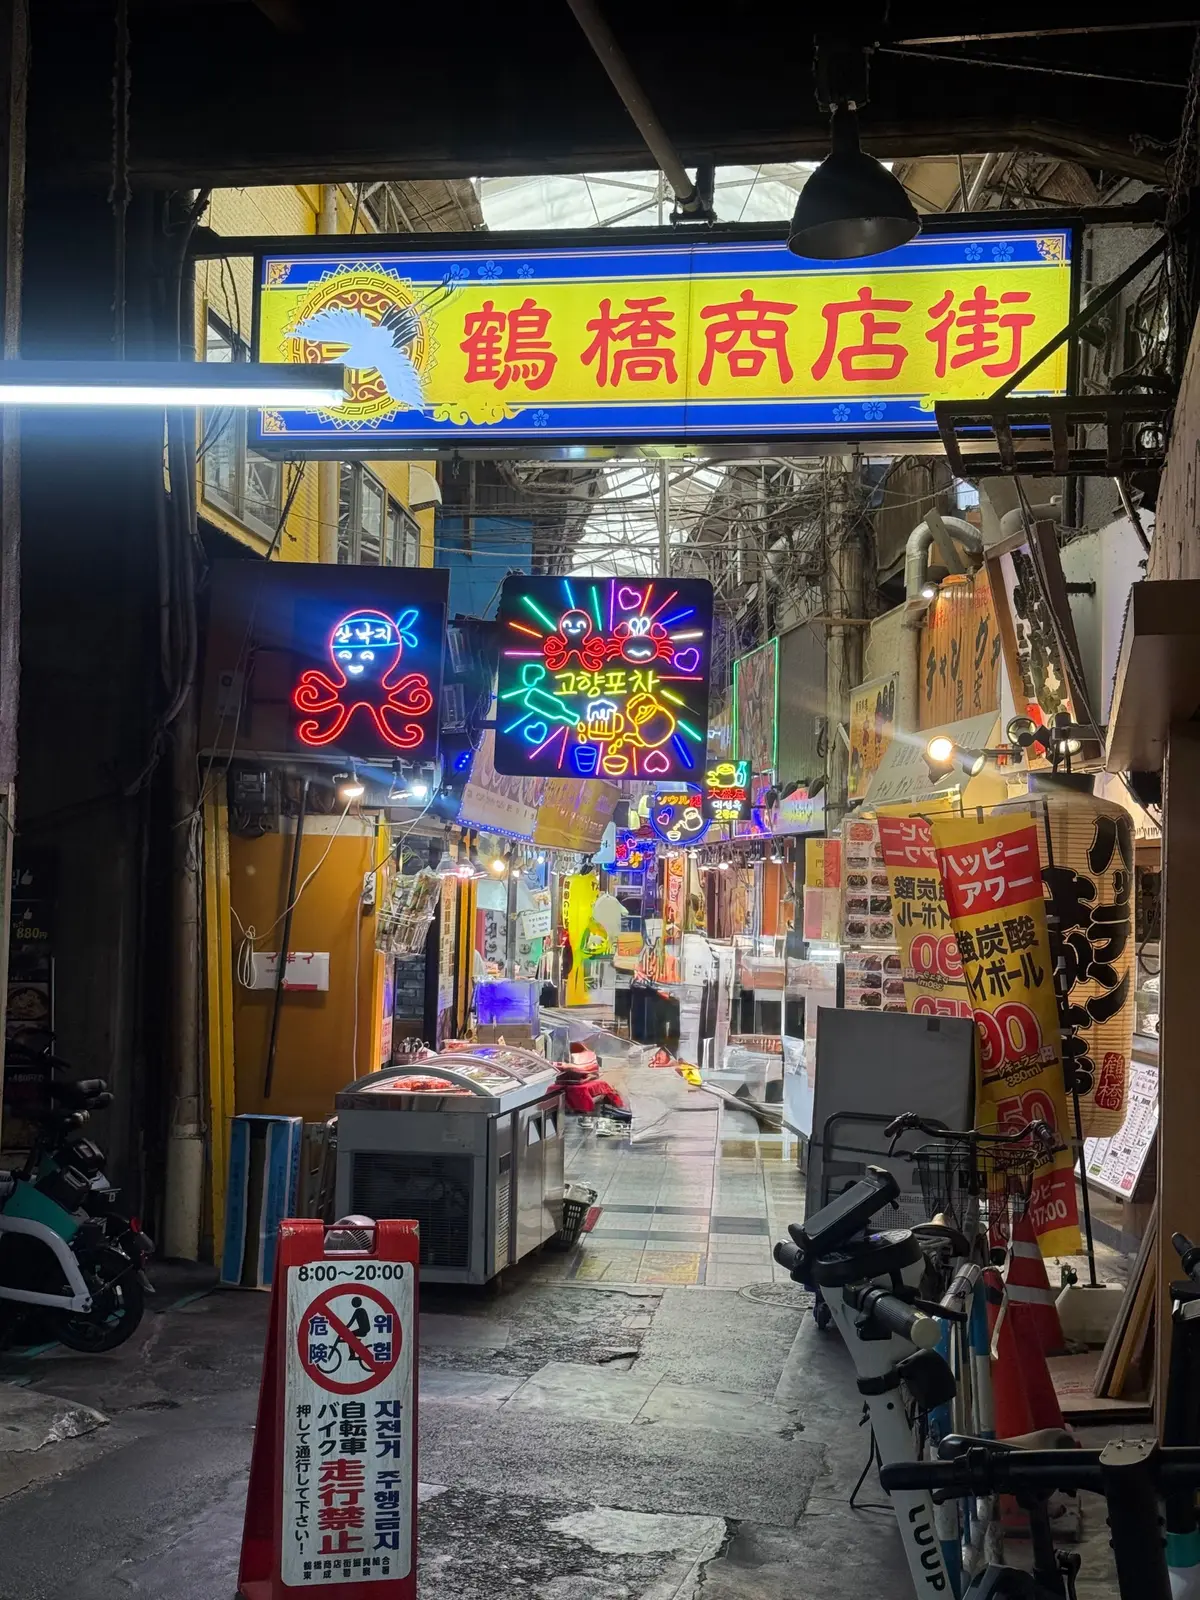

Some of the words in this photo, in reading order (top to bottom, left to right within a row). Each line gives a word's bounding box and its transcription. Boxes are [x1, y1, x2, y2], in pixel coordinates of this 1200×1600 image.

[459, 285, 1039, 391] 鶴橋商店街
[335, 622, 392, 646] 산낙지
[553, 669, 660, 698] 고향포차
[942, 841, 1029, 878] ハッピー
[958, 876, 1034, 909] アワー
[967, 952, 1044, 1001] イボール
[1006, 1062, 1042, 1087] 380ml
[309, 1315, 329, 1364] 危険
[373, 1314, 393, 1361] 위험
[317, 1401, 340, 1457] バイク
[339, 1401, 367, 1456] 自転車
[374, 1400, 402, 1459] 자전거
[317, 1458, 366, 1555] 走行禁止
[373, 1470, 402, 1551] 주행금지
[909, 1504, 946, 1592] LUUP
